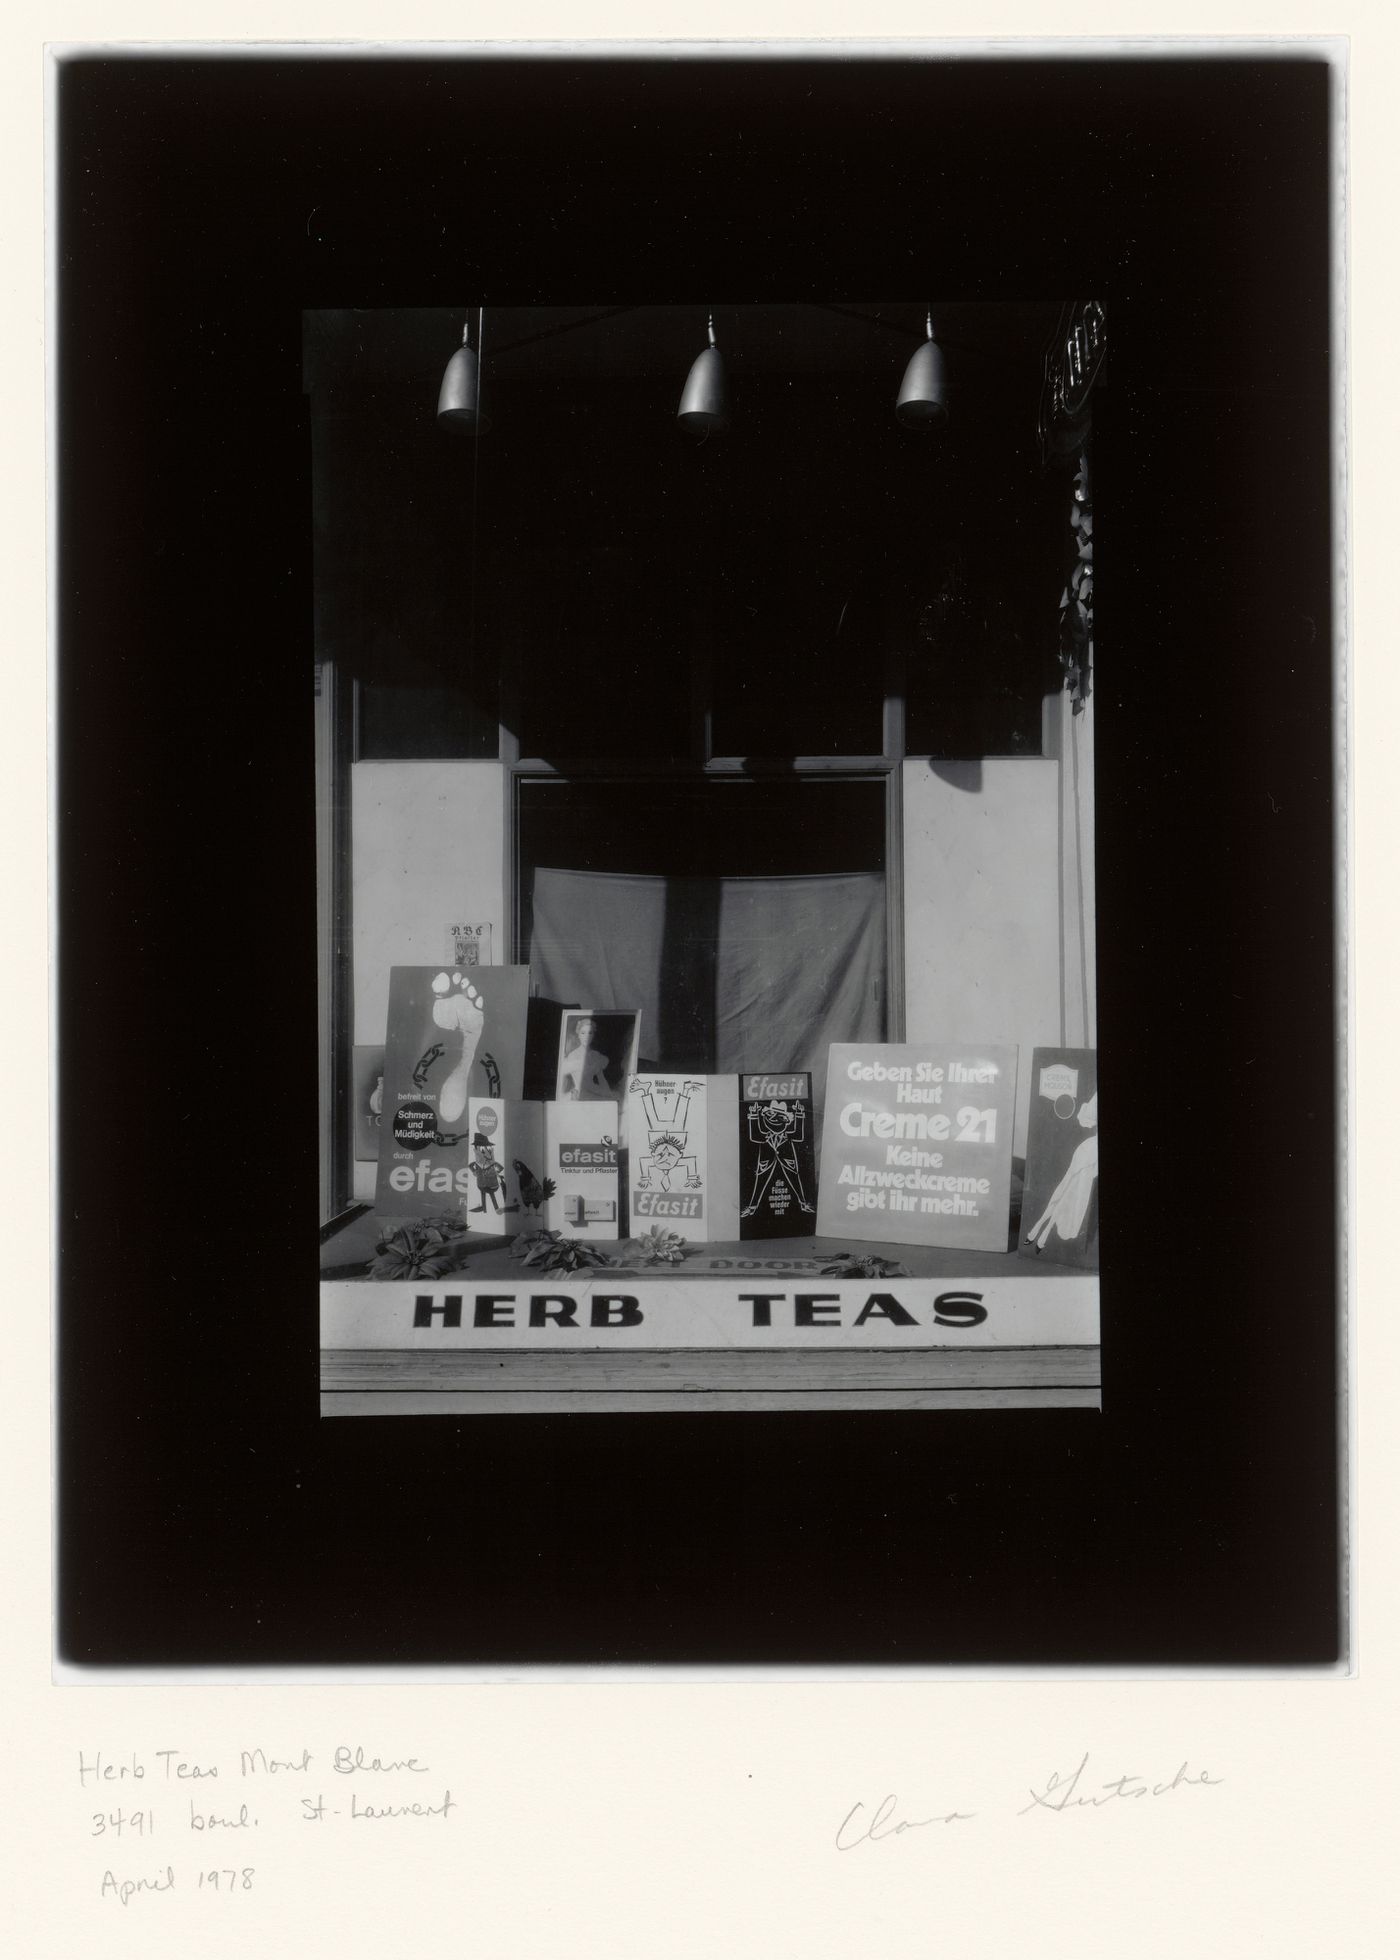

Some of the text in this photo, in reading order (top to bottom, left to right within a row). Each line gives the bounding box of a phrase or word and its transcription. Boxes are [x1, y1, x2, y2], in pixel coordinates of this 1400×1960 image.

[847, 1061, 998, 1084] Geben Sie Ihrer
[397, 1093, 421, 1101] befreit
[747, 1074, 805, 1098] Efasit
[897, 1084, 942, 1104] Haut
[398, 1110, 434, 1120] Schmerz
[407, 1121, 424, 1129] und
[839, 1103, 998, 1144] Creme 21
[394, 1130, 435, 1140] Müdigkeit
[393, 1152, 414, 1160] durch
[561, 1148, 617, 1163] efasit
[886, 1146, 943, 1168] Keine
[837, 1165, 990, 1194] Allzweckcreme
[637, 1193, 698, 1217] Efasit
[846, 1188, 980, 1217] gibt ihr mehr.
[709, 1260, 817, 1270] DOOR
[412, 1291, 989, 1329] HERB TEAS
[79, 1745, 430, 1788] Herb Teas Mont Blanc
[91, 1807, 153, 1837] 3491
[101, 1866, 256, 1907] April 1978
